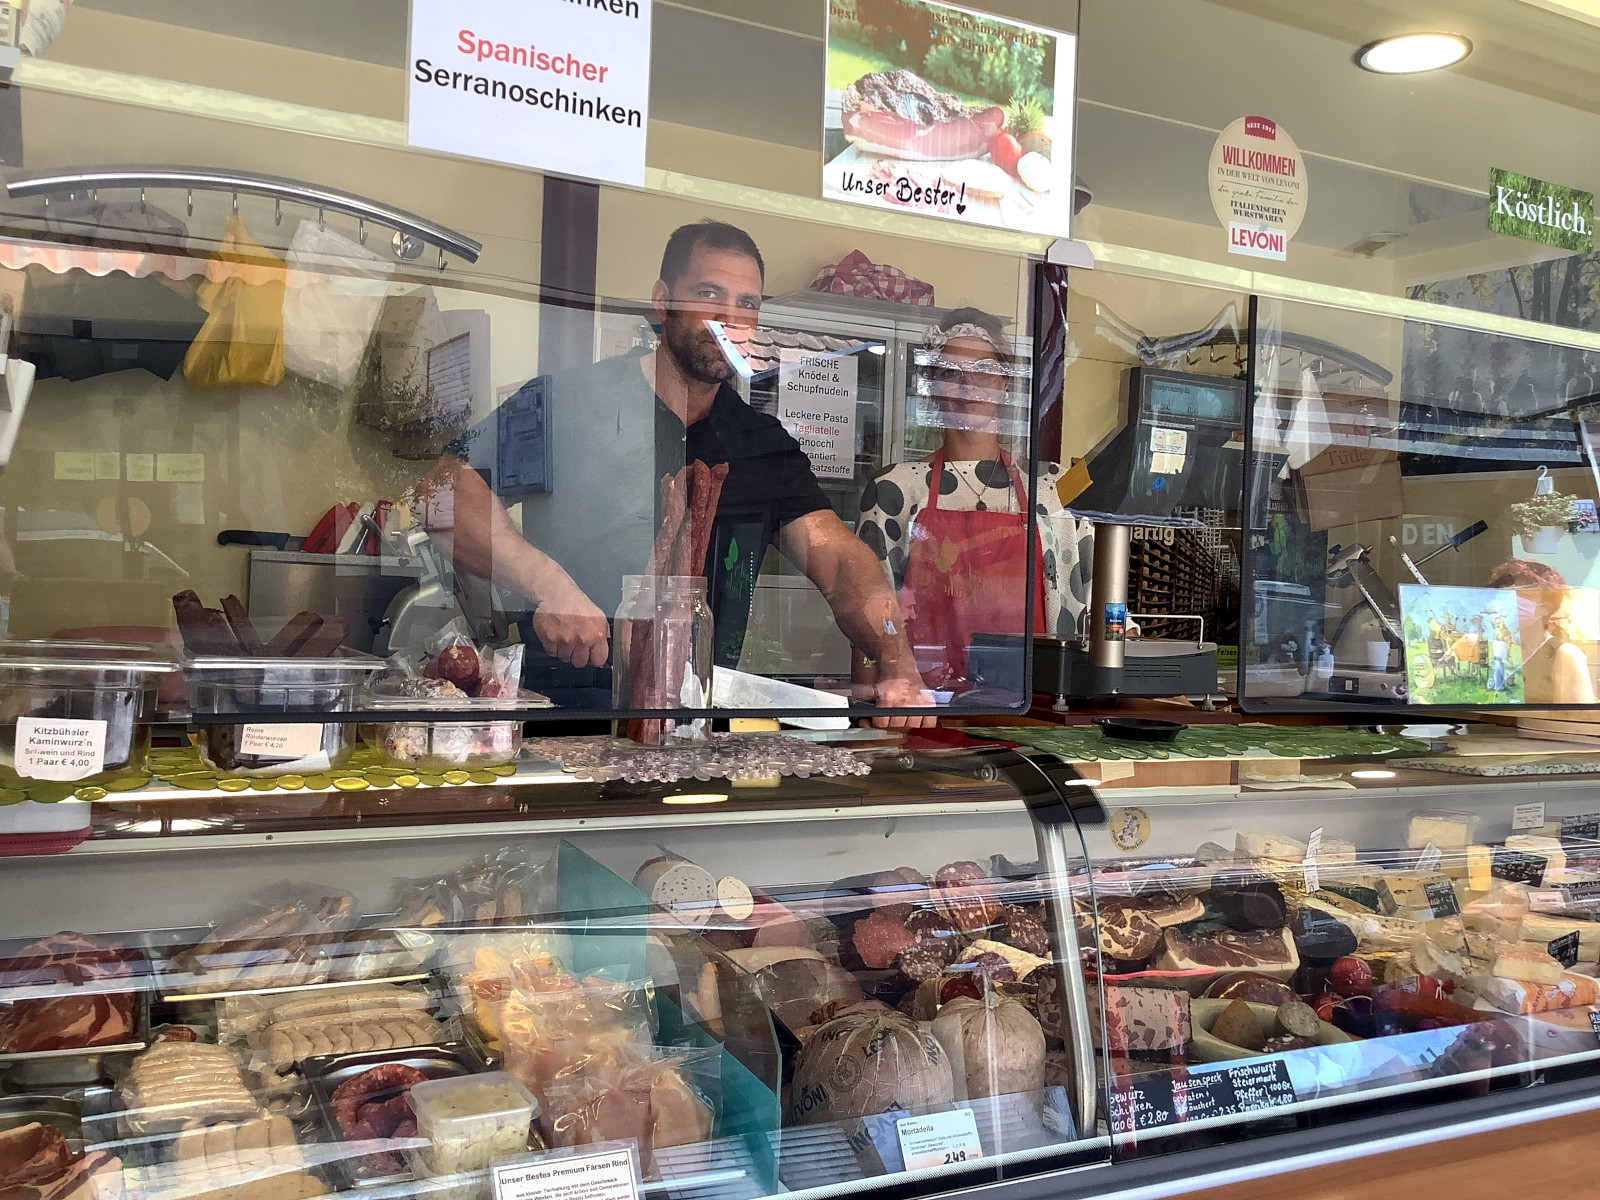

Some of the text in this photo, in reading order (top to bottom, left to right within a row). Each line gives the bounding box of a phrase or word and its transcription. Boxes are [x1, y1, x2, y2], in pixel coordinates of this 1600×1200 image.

[457, 29, 608, 83] Spanischer
[414, 58, 642, 128] Serranoschinken
[1222, 144, 1296, 178] WILLKOMMEN
[1217, 167, 1300, 190] IN DER WELT VON LEVONI
[842, 172, 966, 205] Unser Bester!
[1230, 200, 1287, 217] ITALIENISCHEN
[1495, 185, 1592, 236] Köstlich.
[1233, 209, 1284, 224] WURSTWAREN
[1231, 227, 1284, 253] LEVONI
[800, 356, 840, 369] FRISCHE
[798, 370, 840, 382] Knödel &
[787, 382, 849, 397] Schupfnudeln
[785, 409, 849, 424] Leckere Pasta
[793, 423, 840, 436] Tagliatelle
[798, 437, 834, 449] Gnocchi
[806, 452, 836, 461] rantiert
[810, 463, 850, 474] satzstoffe
[34, 726, 90, 737] Kitzbüheler
[37, 758, 59, 766] Paar
[69, 759, 90, 768] 4,00
[1171, 1072, 1223, 1092] Jausenspeck
[1234, 1086, 1263, 1101] Pfeffer
[1139, 1115, 1147, 1127] €
[901, 1125, 934, 1136] Mortadella
[501, 1175, 524, 1185] Unser
[525, 1172, 551, 1181] Bestes
[552, 1166, 585, 1177] Premium
[612, 1159, 628, 1167] Rind
